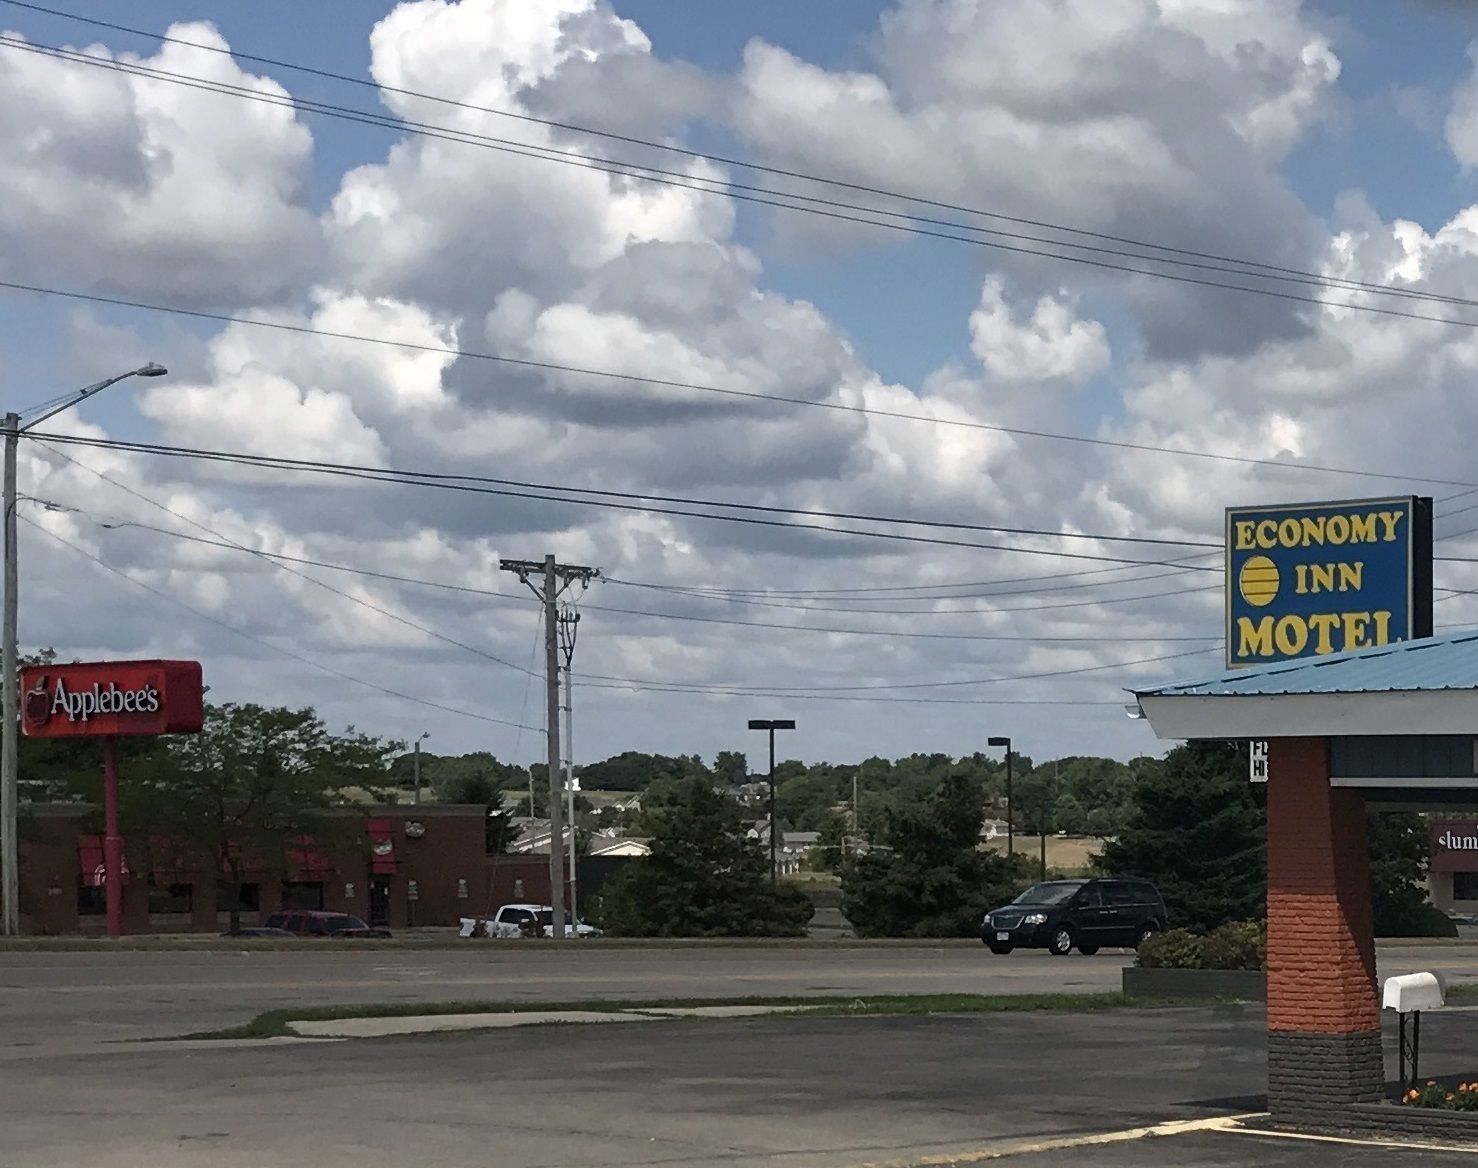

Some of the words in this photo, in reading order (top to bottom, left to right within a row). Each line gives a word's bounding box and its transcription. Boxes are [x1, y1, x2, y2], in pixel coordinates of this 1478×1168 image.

[1235, 511, 1403, 550] ECONOMY
[1295, 561, 1364, 593] INN
[1237, 611, 1402, 657] MOTEL
[51, 677, 159, 722] Applebee's
